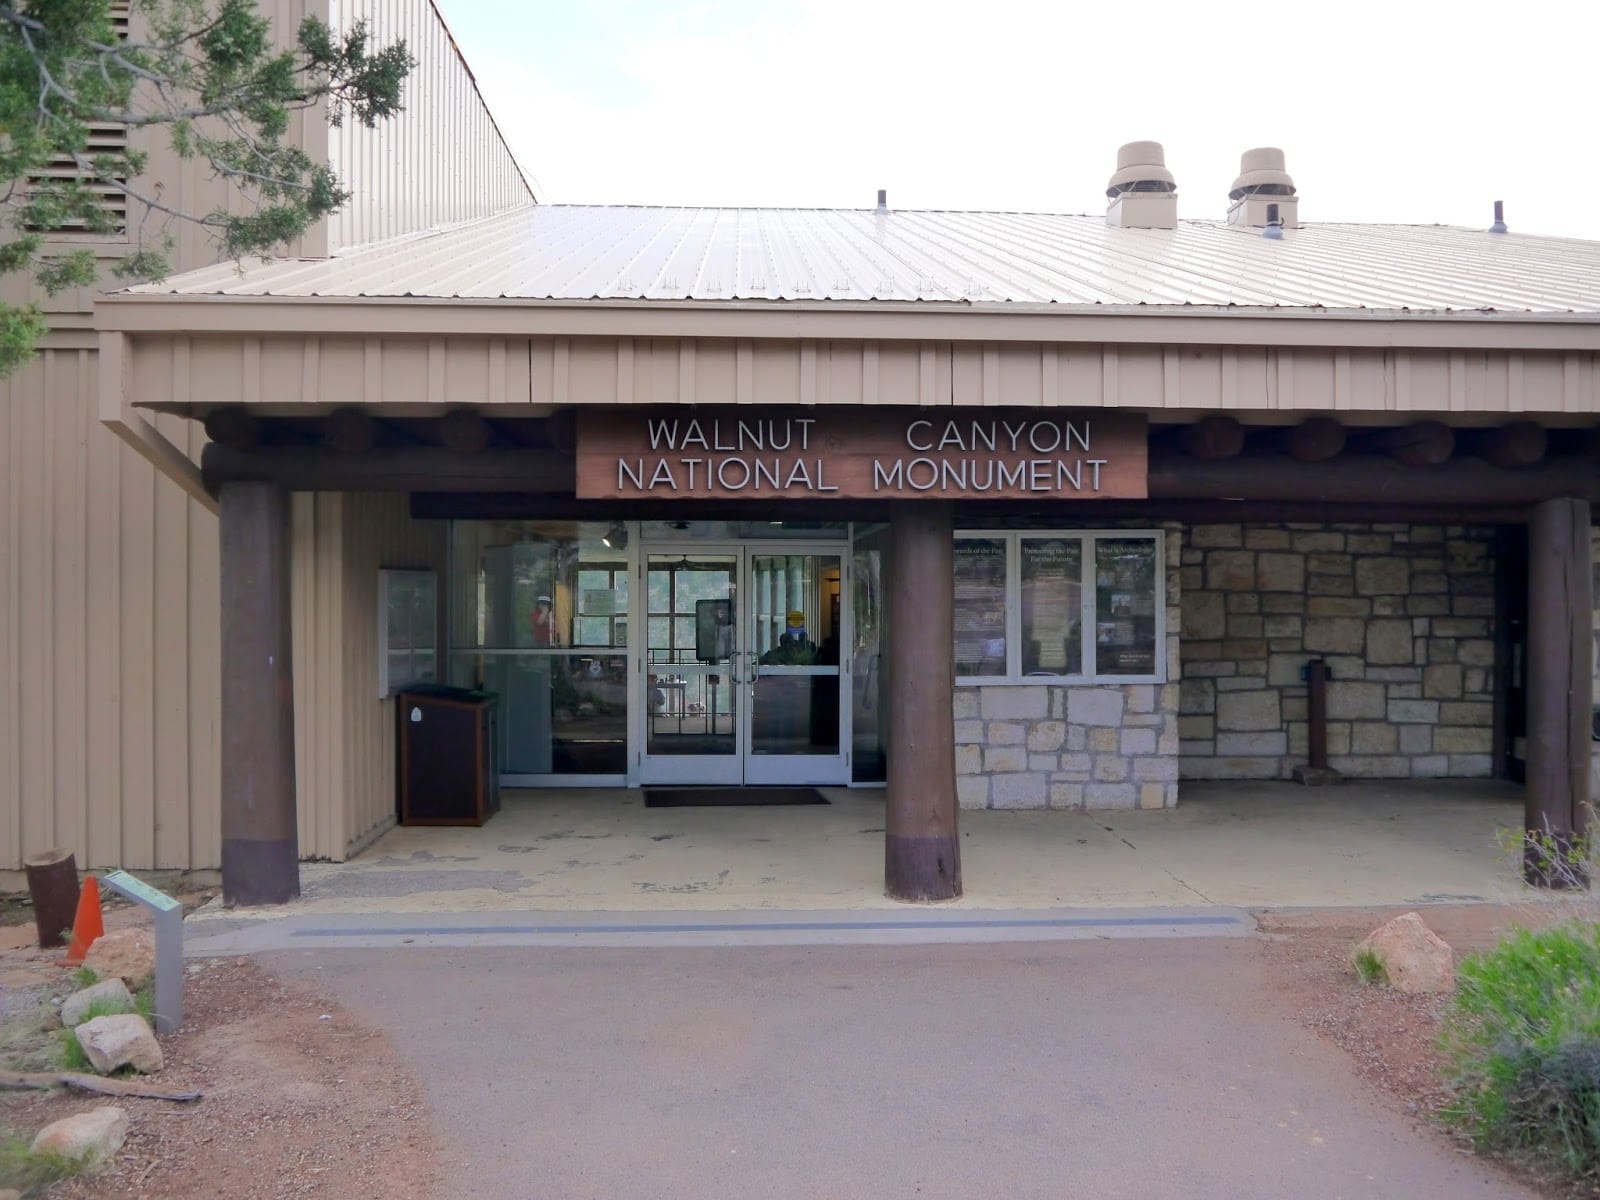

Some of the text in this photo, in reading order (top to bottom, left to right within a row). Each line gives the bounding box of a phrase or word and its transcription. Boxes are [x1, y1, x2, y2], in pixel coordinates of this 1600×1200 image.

[648, 418, 1090, 452] WALNUT CANYON
[617, 457, 1108, 491] NATIONAL MONUMENT
